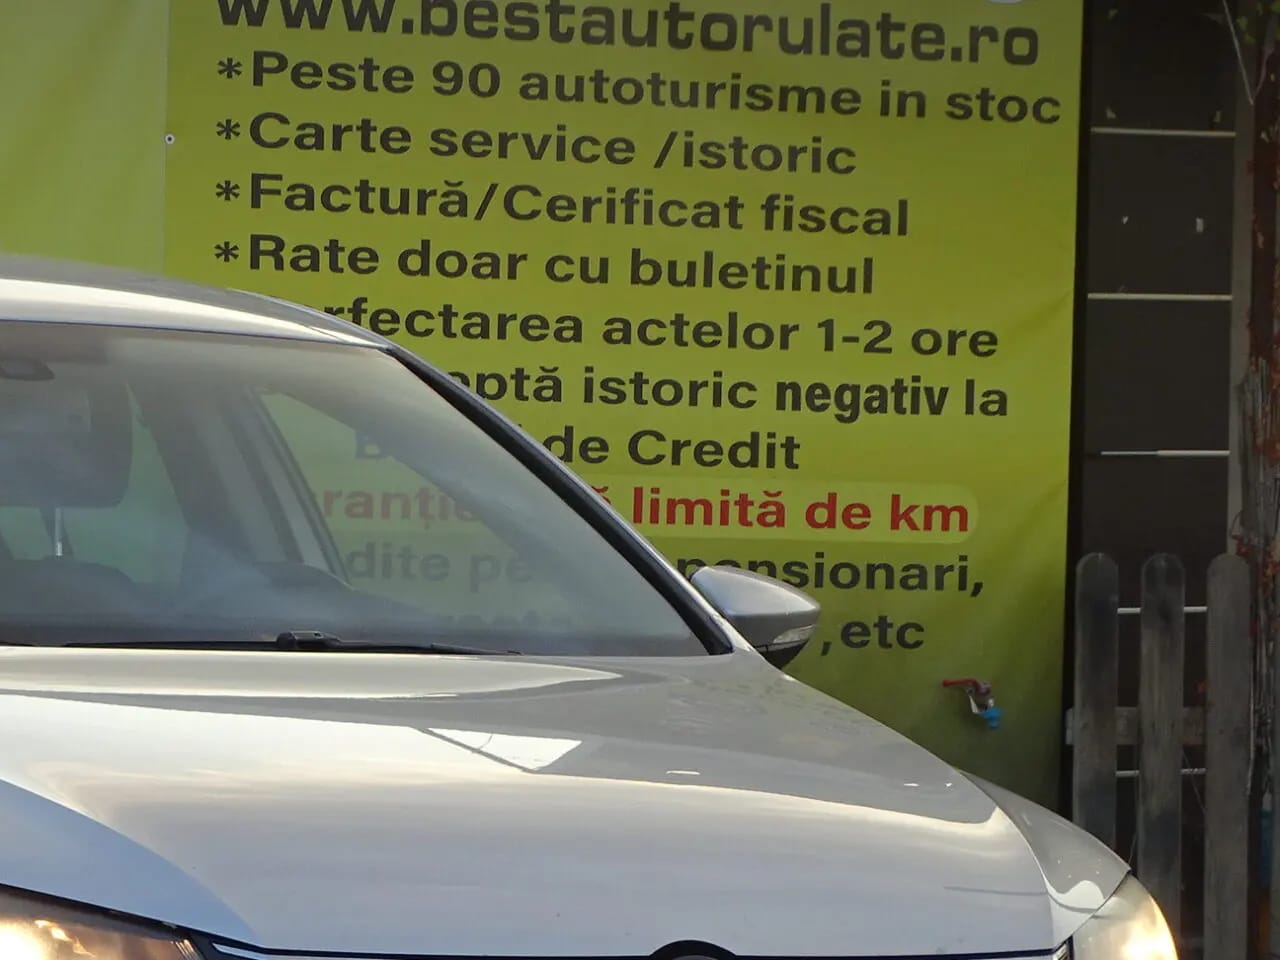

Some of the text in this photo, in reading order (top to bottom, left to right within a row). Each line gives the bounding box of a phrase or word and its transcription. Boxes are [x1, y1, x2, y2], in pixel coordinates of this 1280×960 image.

[218, 0, 1039, 66] www.bestautorulate.ro
[433, 61, 501, 98] 90
[520, 70, 862, 115] autoturisme
[880, 80, 926, 118] in
[946, 88, 1061, 124] stoc
[430, 124, 635, 164] service
[654, 131, 857, 174] /istoric
[761, 194, 908, 236] fiscal
[398, 239, 528, 280] doar
[545, 255, 609, 284] cu
[631, 248, 874, 294] buletinul
[603, 312, 800, 350] actelor
[818, 319, 893, 354] 1-2
[912, 328, 998, 357] ore
[584, 366, 757, 408] istoric
[776, 376, 949, 424] negativ
[965, 379, 1008, 416] la
[543, 425, 800, 470] de Credit
[632, 487, 786, 528] limită
[805, 492, 872, 531] de
[890, 494, 969, 532] km
